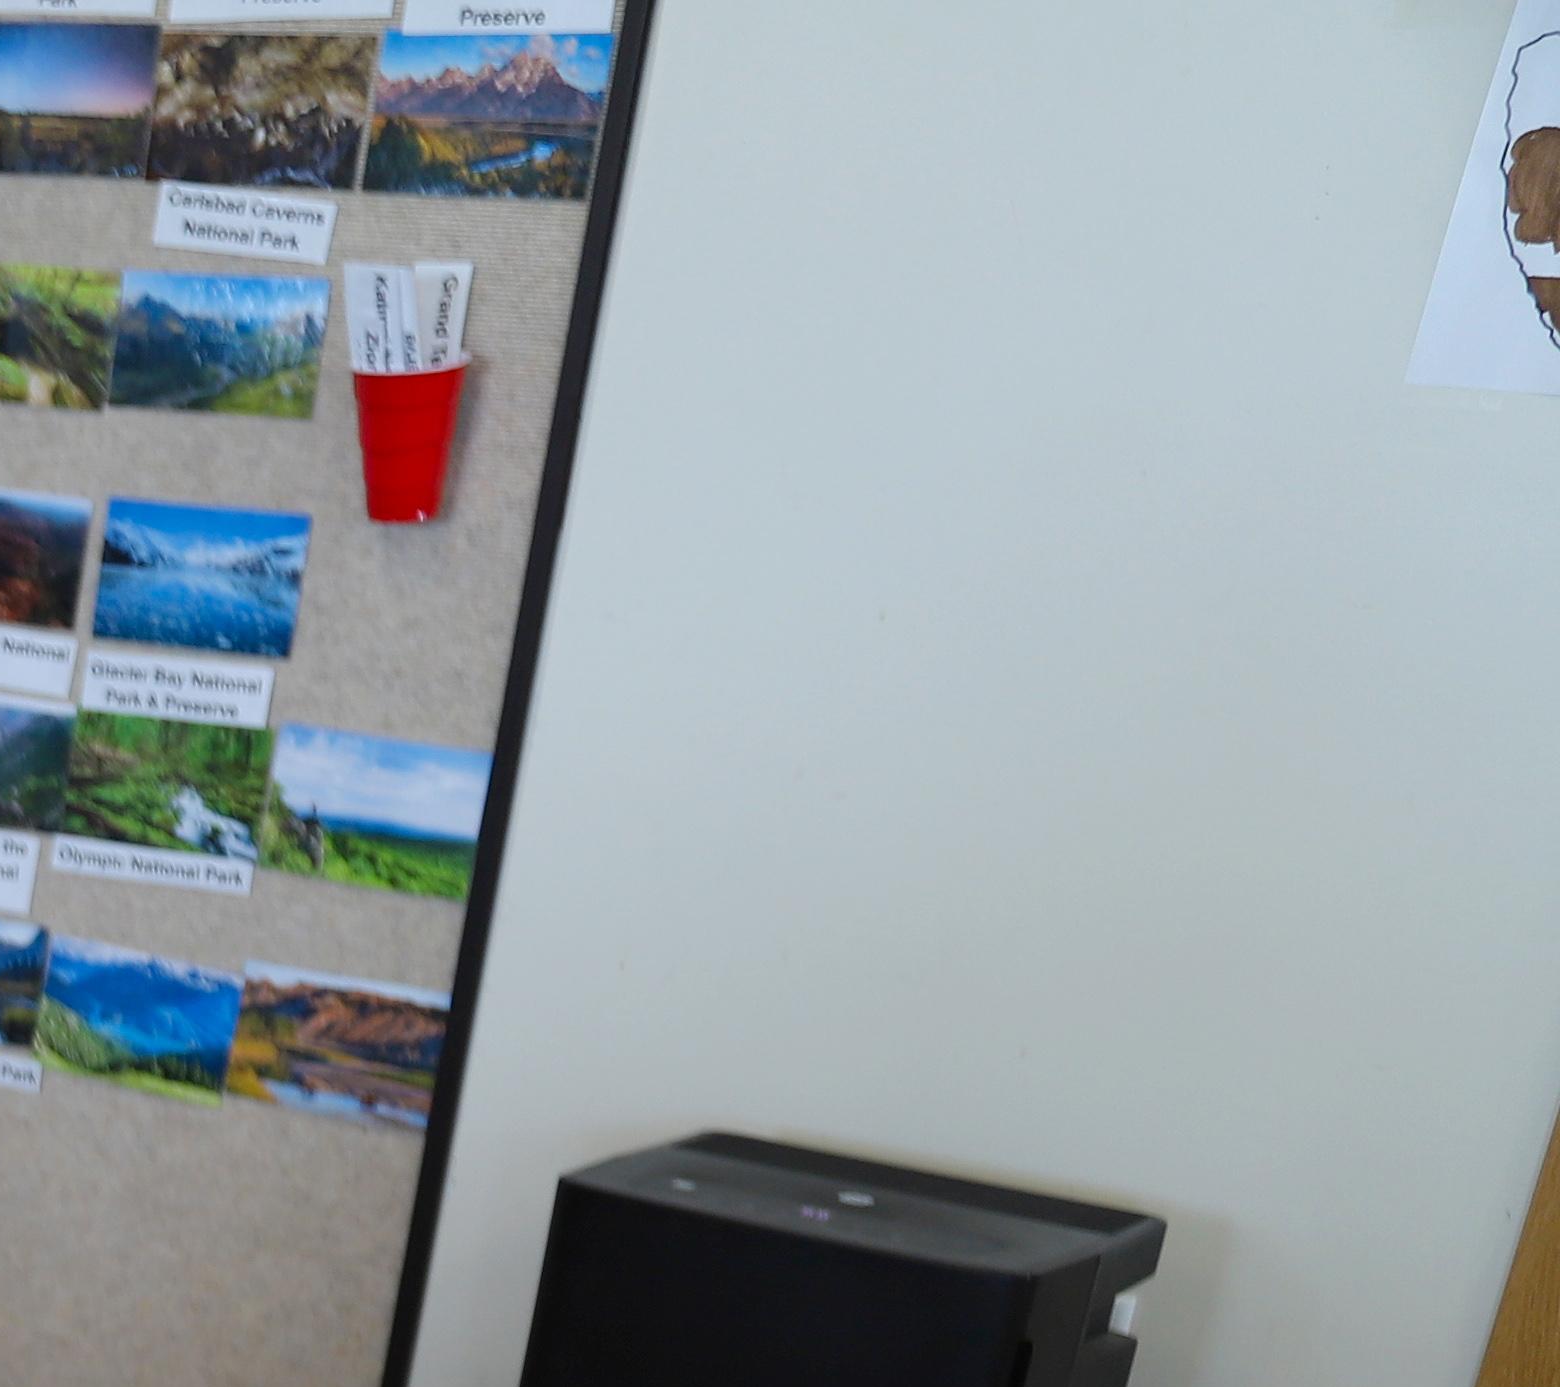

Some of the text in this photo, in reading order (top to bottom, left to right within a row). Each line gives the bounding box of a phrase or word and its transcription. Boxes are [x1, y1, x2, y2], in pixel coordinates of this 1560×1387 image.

[457, 7, 546, 27] Preserve
[169, 190, 326, 225] Carlsbad Caverns
[183, 219, 300, 251] National Park
[2, 635, 72, 664] National
[90, 660, 263, 694] Glacier Bay National
[105, 689, 239, 718] Park & Preserve
[4, 838, 29, 855] the
[58, 846, 244, 887] Olympic National Park
[1, 1064, 37, 1084] Park
